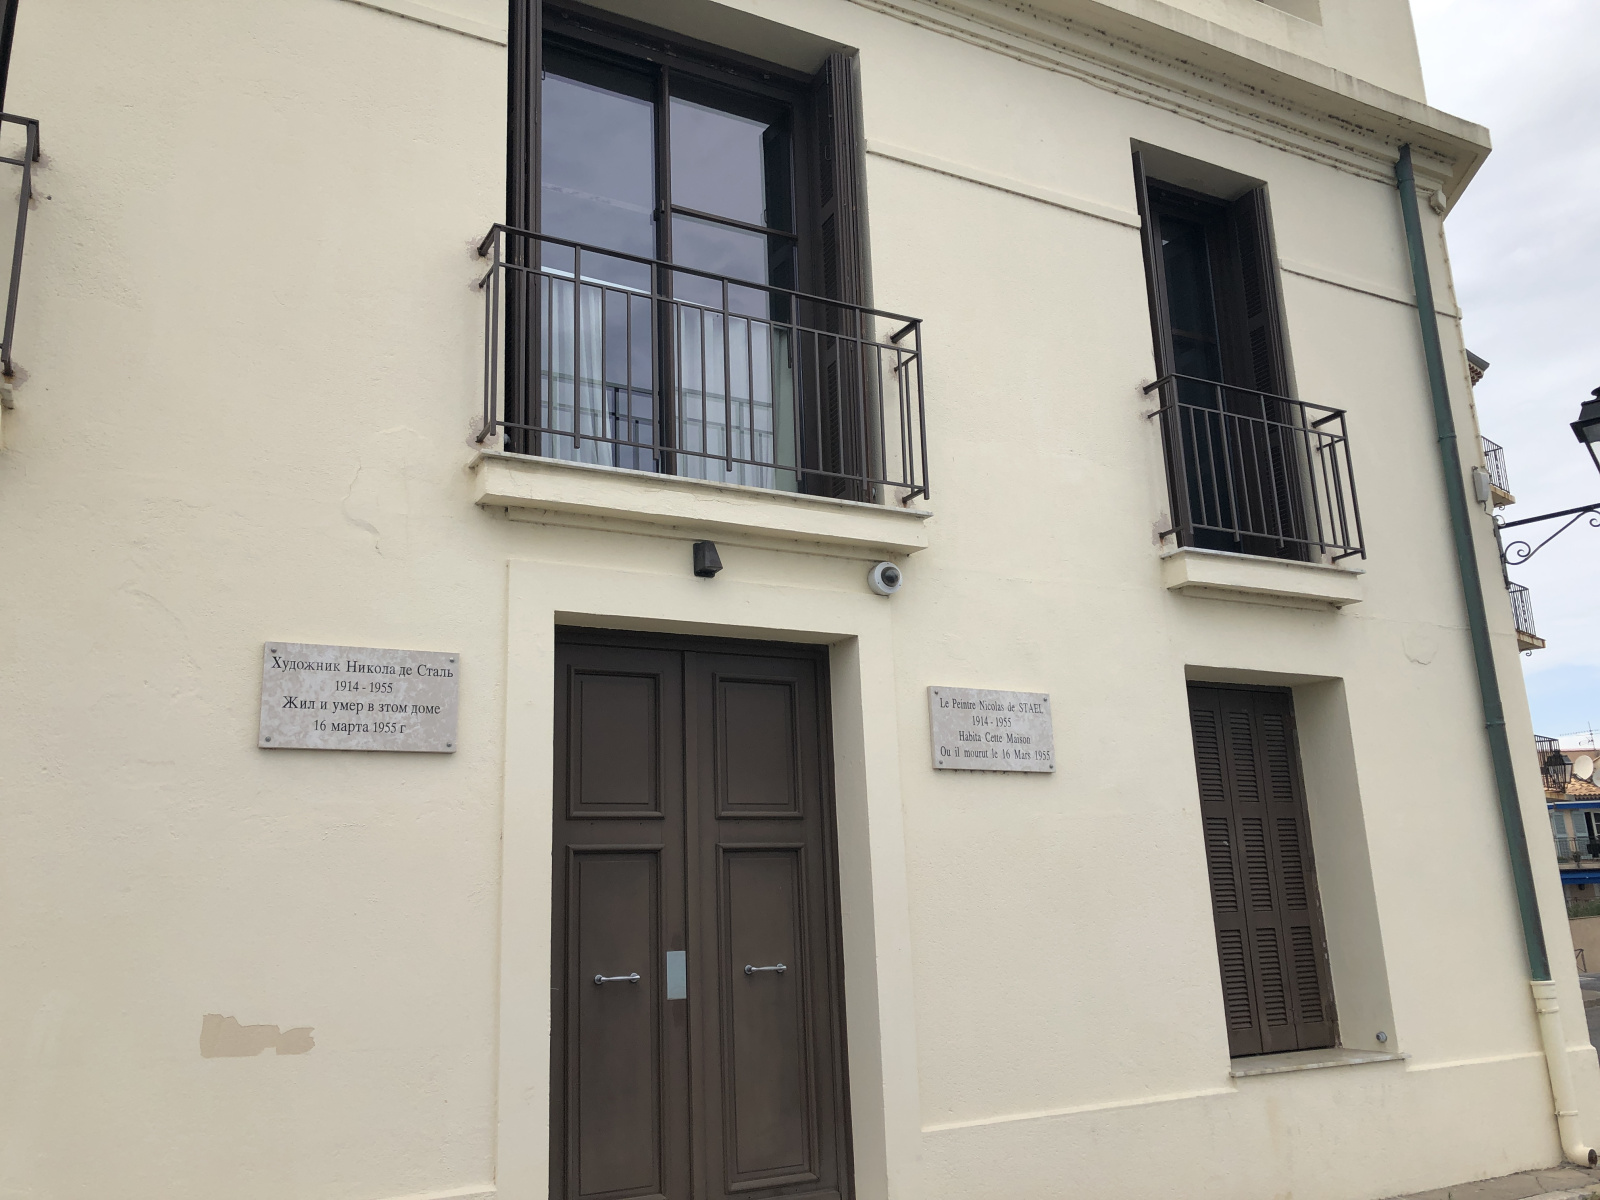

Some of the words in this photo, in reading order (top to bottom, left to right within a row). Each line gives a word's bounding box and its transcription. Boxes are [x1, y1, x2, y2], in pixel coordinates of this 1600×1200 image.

[271, 656, 340, 672] Художник
[346, 660, 396, 675] Никола
[399, 665, 413, 677] де
[417, 664, 454, 678] Сталь
[335, 680, 359, 692] 1914
[369, 682, 393, 693] 1955
[282, 695, 315, 710] Жил
[320, 701, 327, 710] и
[332, 702, 364, 714] умер
[367, 703, 374, 712] в
[411, 704, 441, 715] доме
[940, 698, 949, 708] Le
[952, 699, 976, 709] Peintre
[979, 700, 1004, 711] Nicolas
[1007, 702, 1015, 712] de
[1019, 703, 1043, 714] STAEL
[313, 719, 326, 731] 16
[331, 722, 369, 735] марта
[373, 722, 396, 733] 1955
[400, 724, 407, 733] г
[972, 716, 988, 726] 1914
[995, 717, 1011, 727] 1955
[959, 731, 981, 741] Habita
[985, 732, 1002, 743] Cette
[1006, 733, 1031, 744] Maison
[955, 747, 960, 757] il
[964, 749, 988, 758] mourut
[991, 748, 999, 759] le
[1002, 749, 1010, 759] 16
[1014, 750, 1031, 760] Mars
[1034, 751, 1051, 760] 1955
